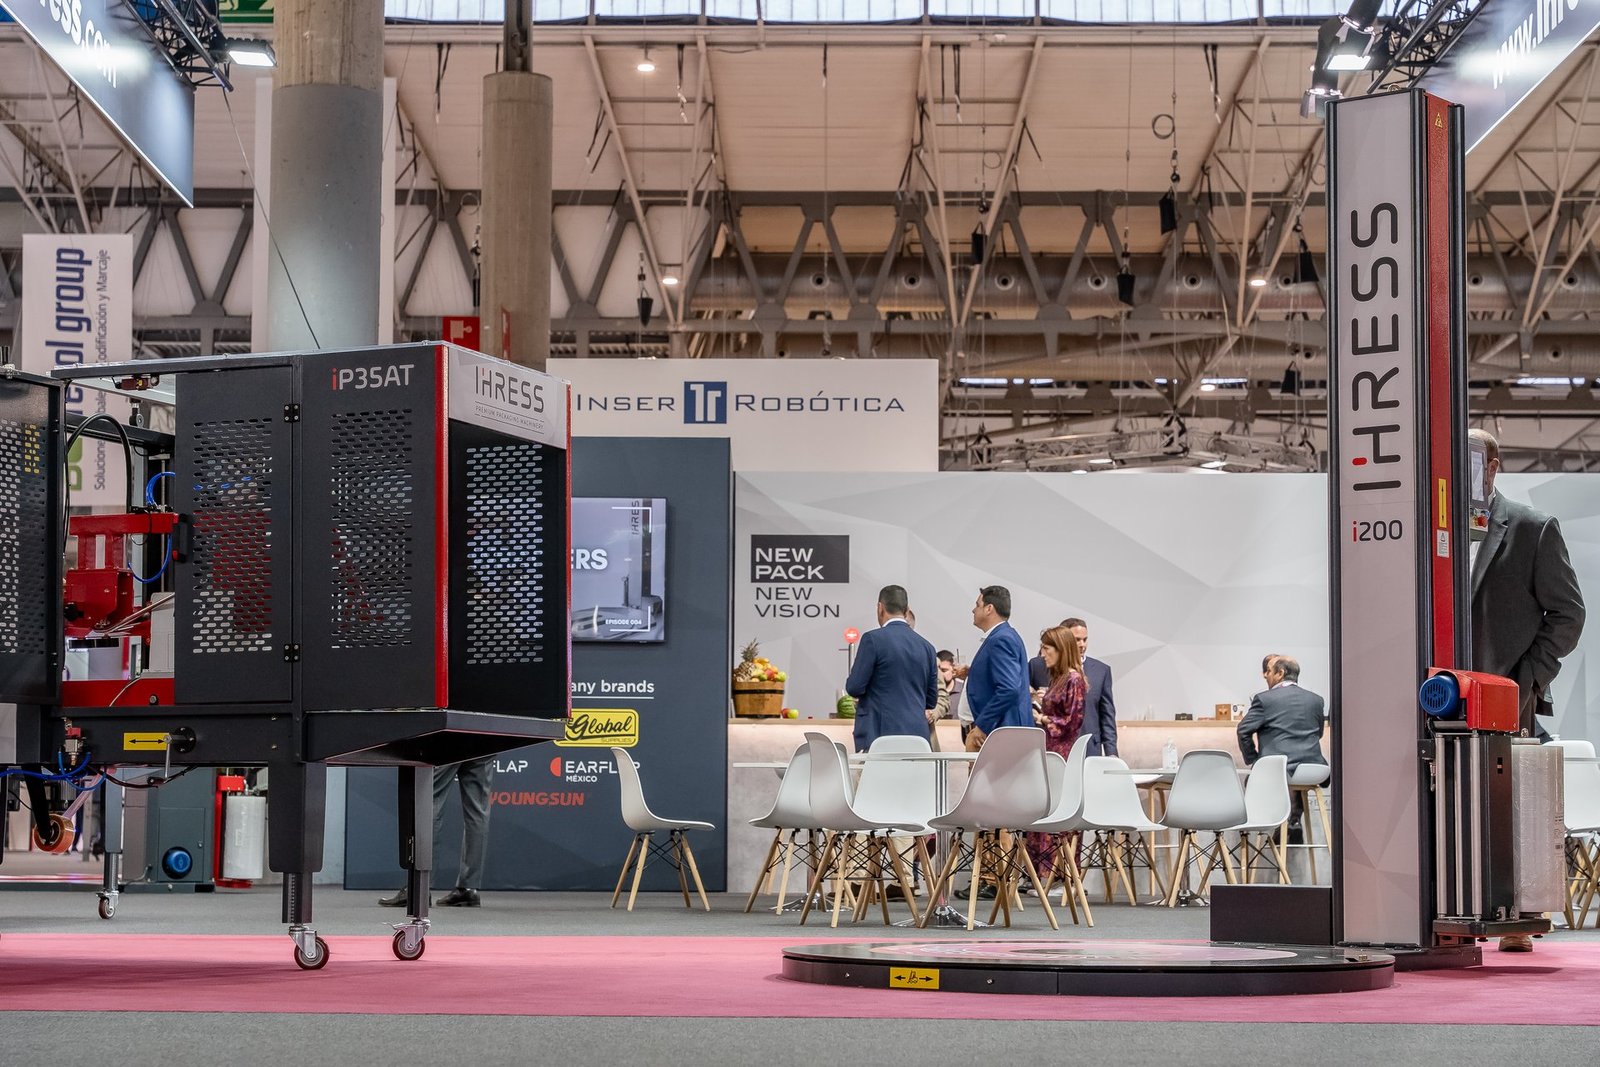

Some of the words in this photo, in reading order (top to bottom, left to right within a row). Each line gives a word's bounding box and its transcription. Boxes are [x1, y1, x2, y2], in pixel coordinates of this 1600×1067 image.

[96, 249, 111, 292] Marcaje
[55, 247, 92, 333] group
[1350, 202, 1402, 492] IHRESS
[475, 365, 545, 414] IHRESS
[576, 394, 676, 412] INSER
[735, 390, 905, 412] ROBÓTICA
[1352, 519, 1404, 543] i200
[571, 548, 608, 570] RS
[755, 547, 814, 562] NEW
[755, 564, 824, 580] PACK
[756, 587, 813, 600] NEW
[754, 604, 840, 618] VISION
[600, 679, 655, 693] brands
[566, 714, 633, 741] Global
[493, 760, 528, 773] LAP
[565, 760, 641, 774] EARFLP
[566, 774, 598, 783] MÉXICO
